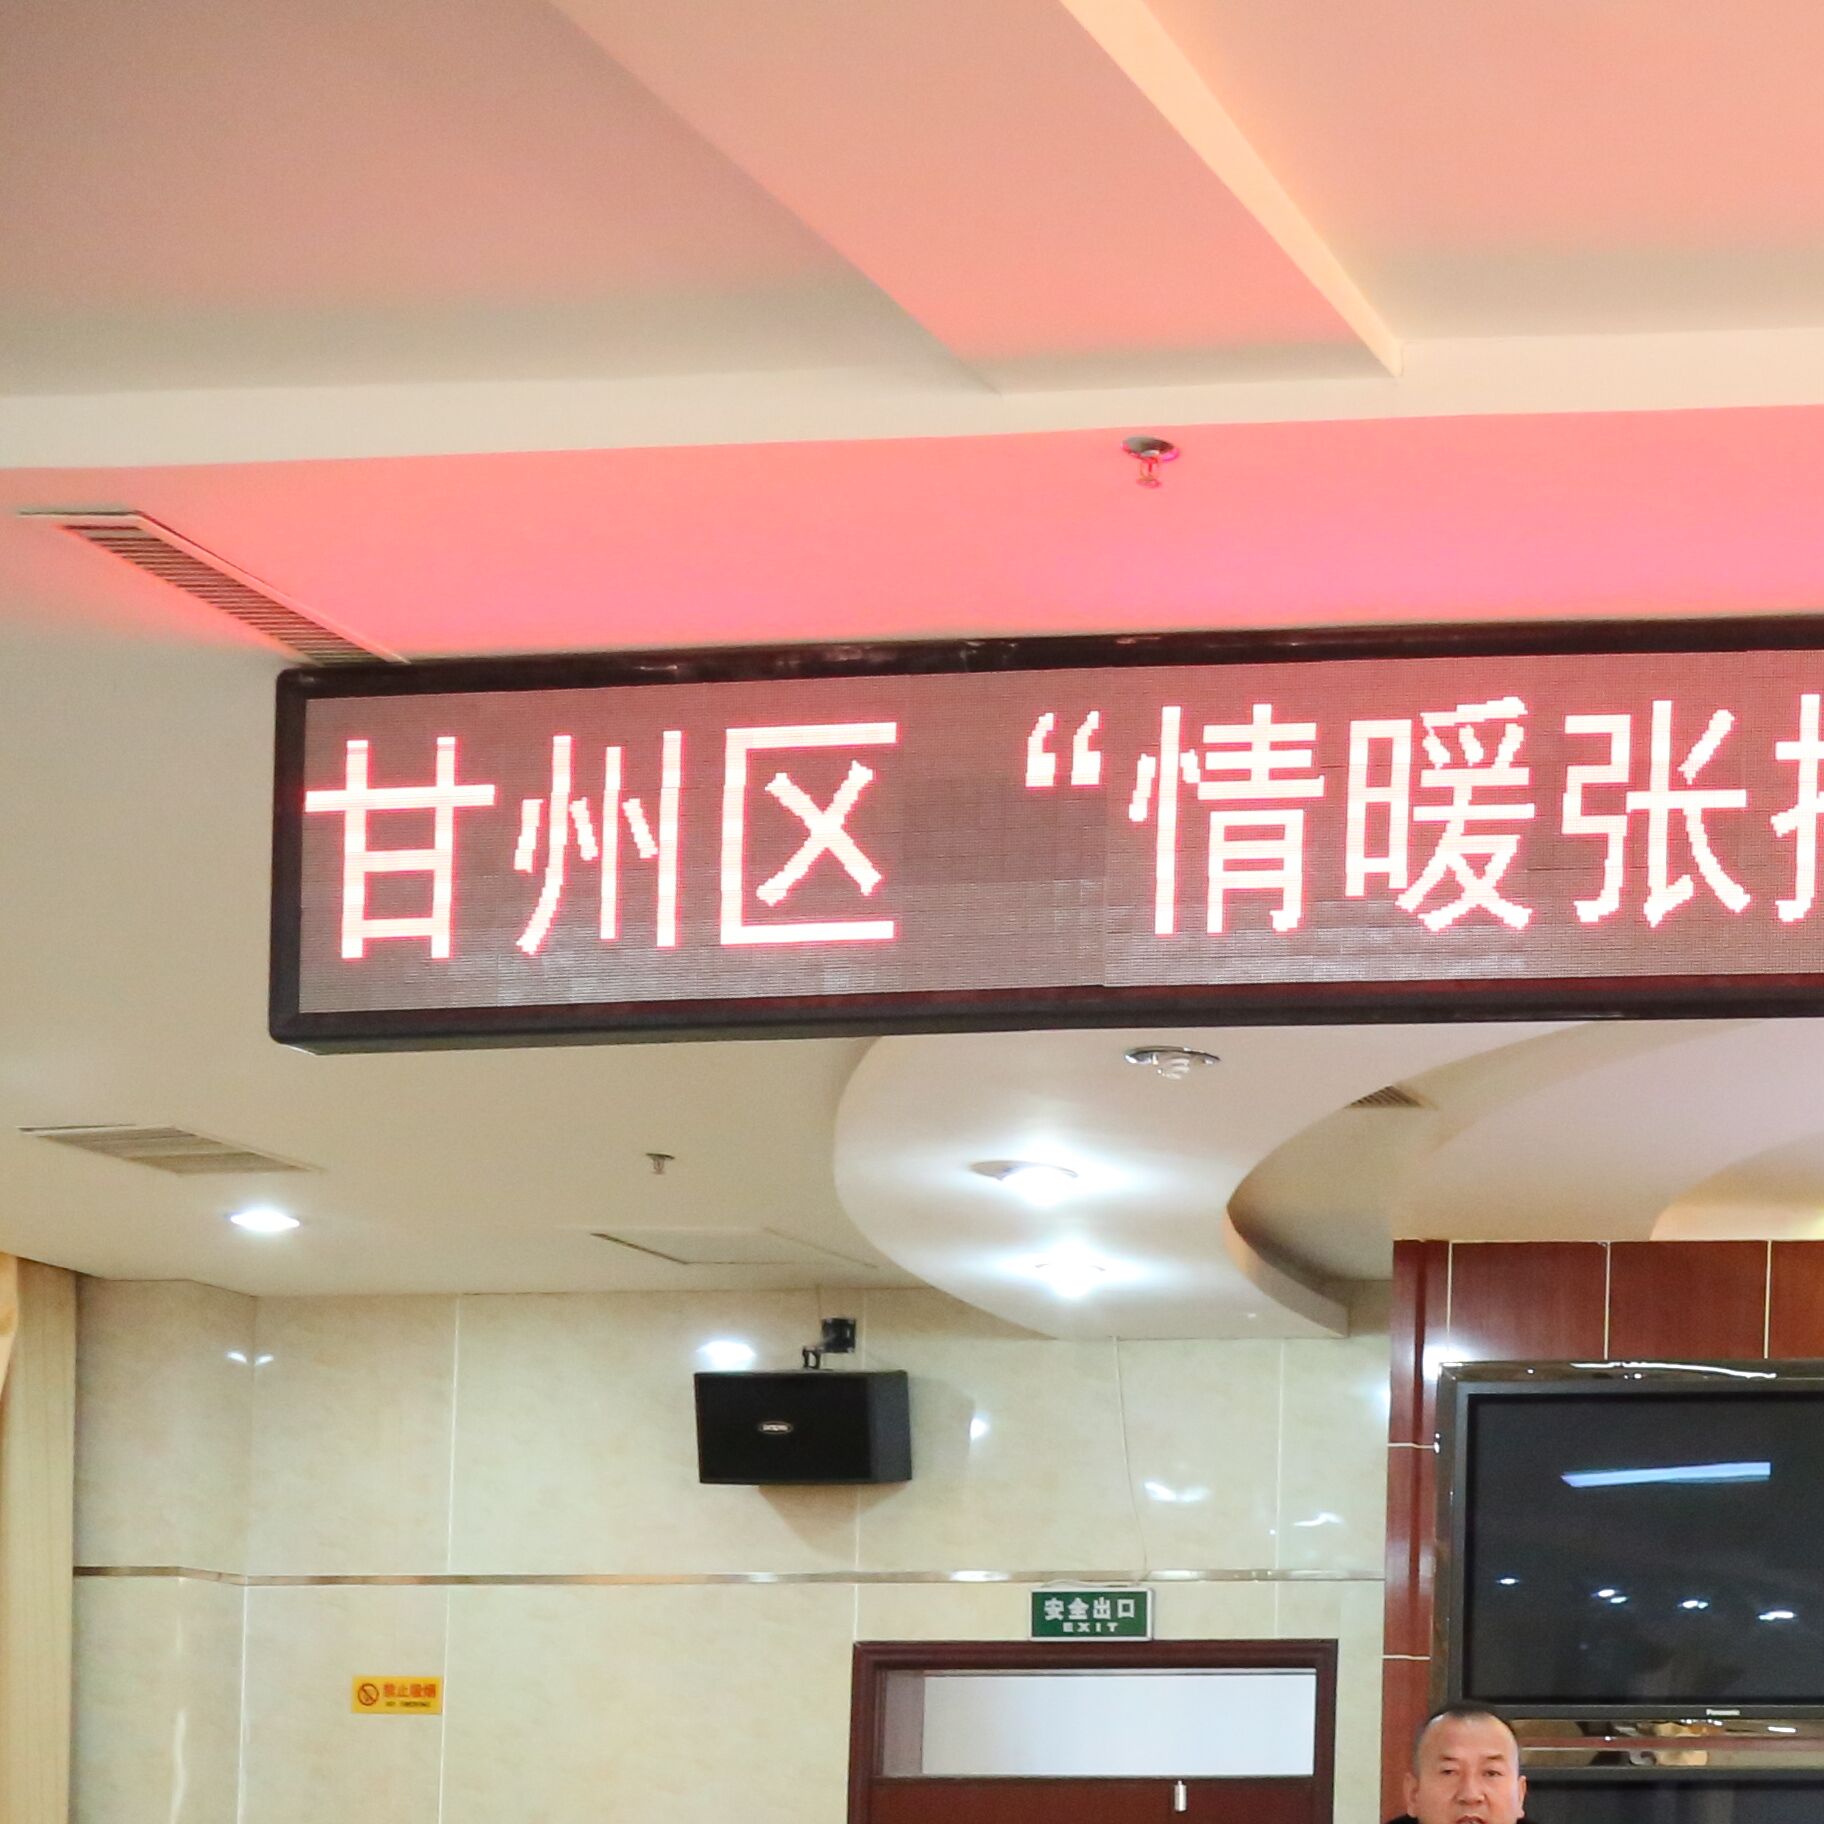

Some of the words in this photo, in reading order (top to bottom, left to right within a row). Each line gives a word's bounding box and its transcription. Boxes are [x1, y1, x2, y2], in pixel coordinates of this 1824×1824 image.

[304, 719, 898, 960] 甘州区
[1044, 1597, 1135, 1621] 安全出口
[1063, 1622, 1118, 1632] EXIT
